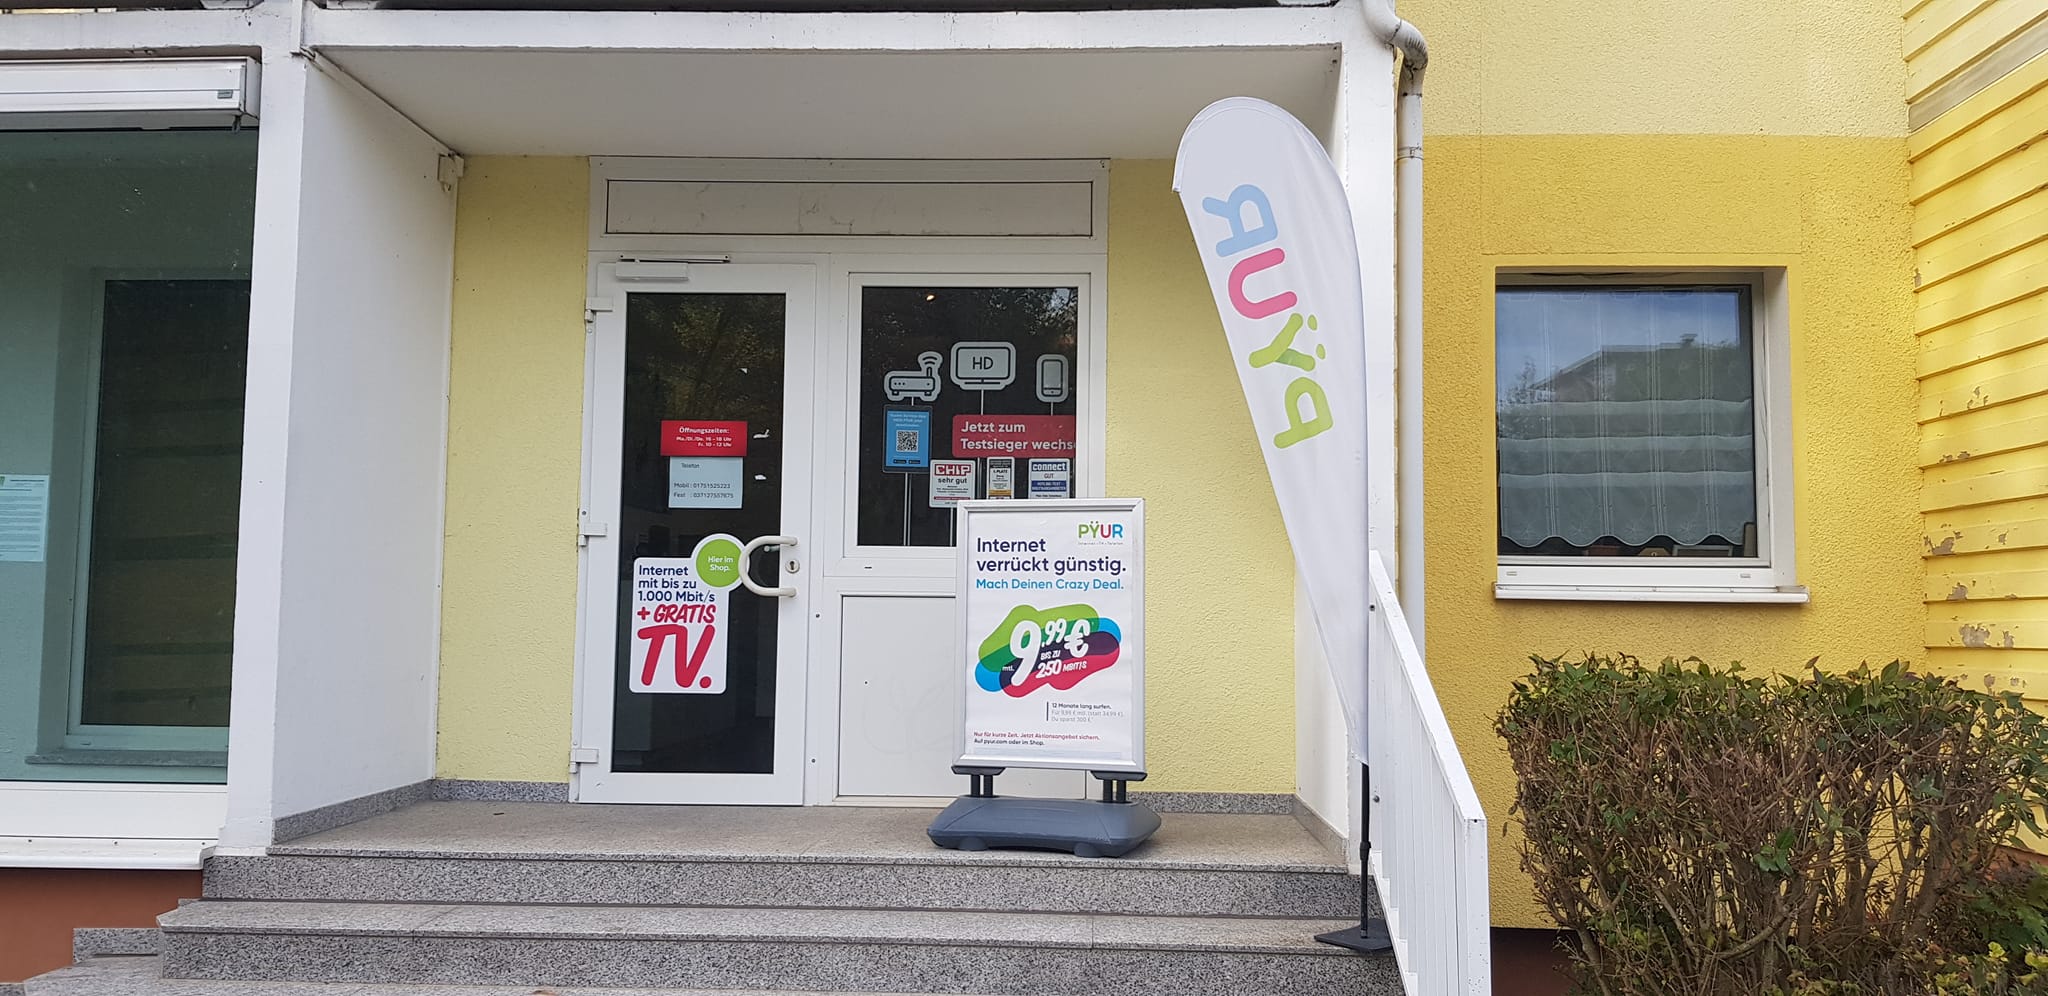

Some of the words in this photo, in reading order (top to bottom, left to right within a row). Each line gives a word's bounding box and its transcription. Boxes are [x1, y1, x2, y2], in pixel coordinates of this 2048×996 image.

[972, 356, 994, 370] HD
[679, 426, 730, 435] Öffnungszeiten:
[961, 421, 995, 432] Jetzt
[998, 424, 1026, 432] zum
[960, 438, 1028, 452] Testsieger
[935, 464, 971, 476] CHIP
[1032, 462, 1066, 471] connect
[1078, 521, 1123, 539] PŸUR
[977, 537, 1046, 552] Internet
[638, 564, 688, 576] Internet
[710, 564, 731, 572] Shop.
[977, 556, 1049, 572] verrückt
[1054, 556, 1126, 576] günstig.
[638, 578, 660, 589] mit
[662, 578, 680, 589] bis
[683, 580, 696, 589] zu
[976, 579, 1008, 589] Mach
[1012, 579, 1052, 589] Deinen
[1056, 579, 1090, 592] Crazy
[1093, 579, 1124, 590] Deal.
[638, 591, 672, 602] 1.000
[676, 590, 716, 602] Mbit/s
[653, 604, 716, 624] GRATIS
[638, 624, 716, 688] TV.
[1040, 650, 1052, 660] BIS
[1052, 650, 1061, 658] ZU
[1036, 658, 1062, 678] 250
